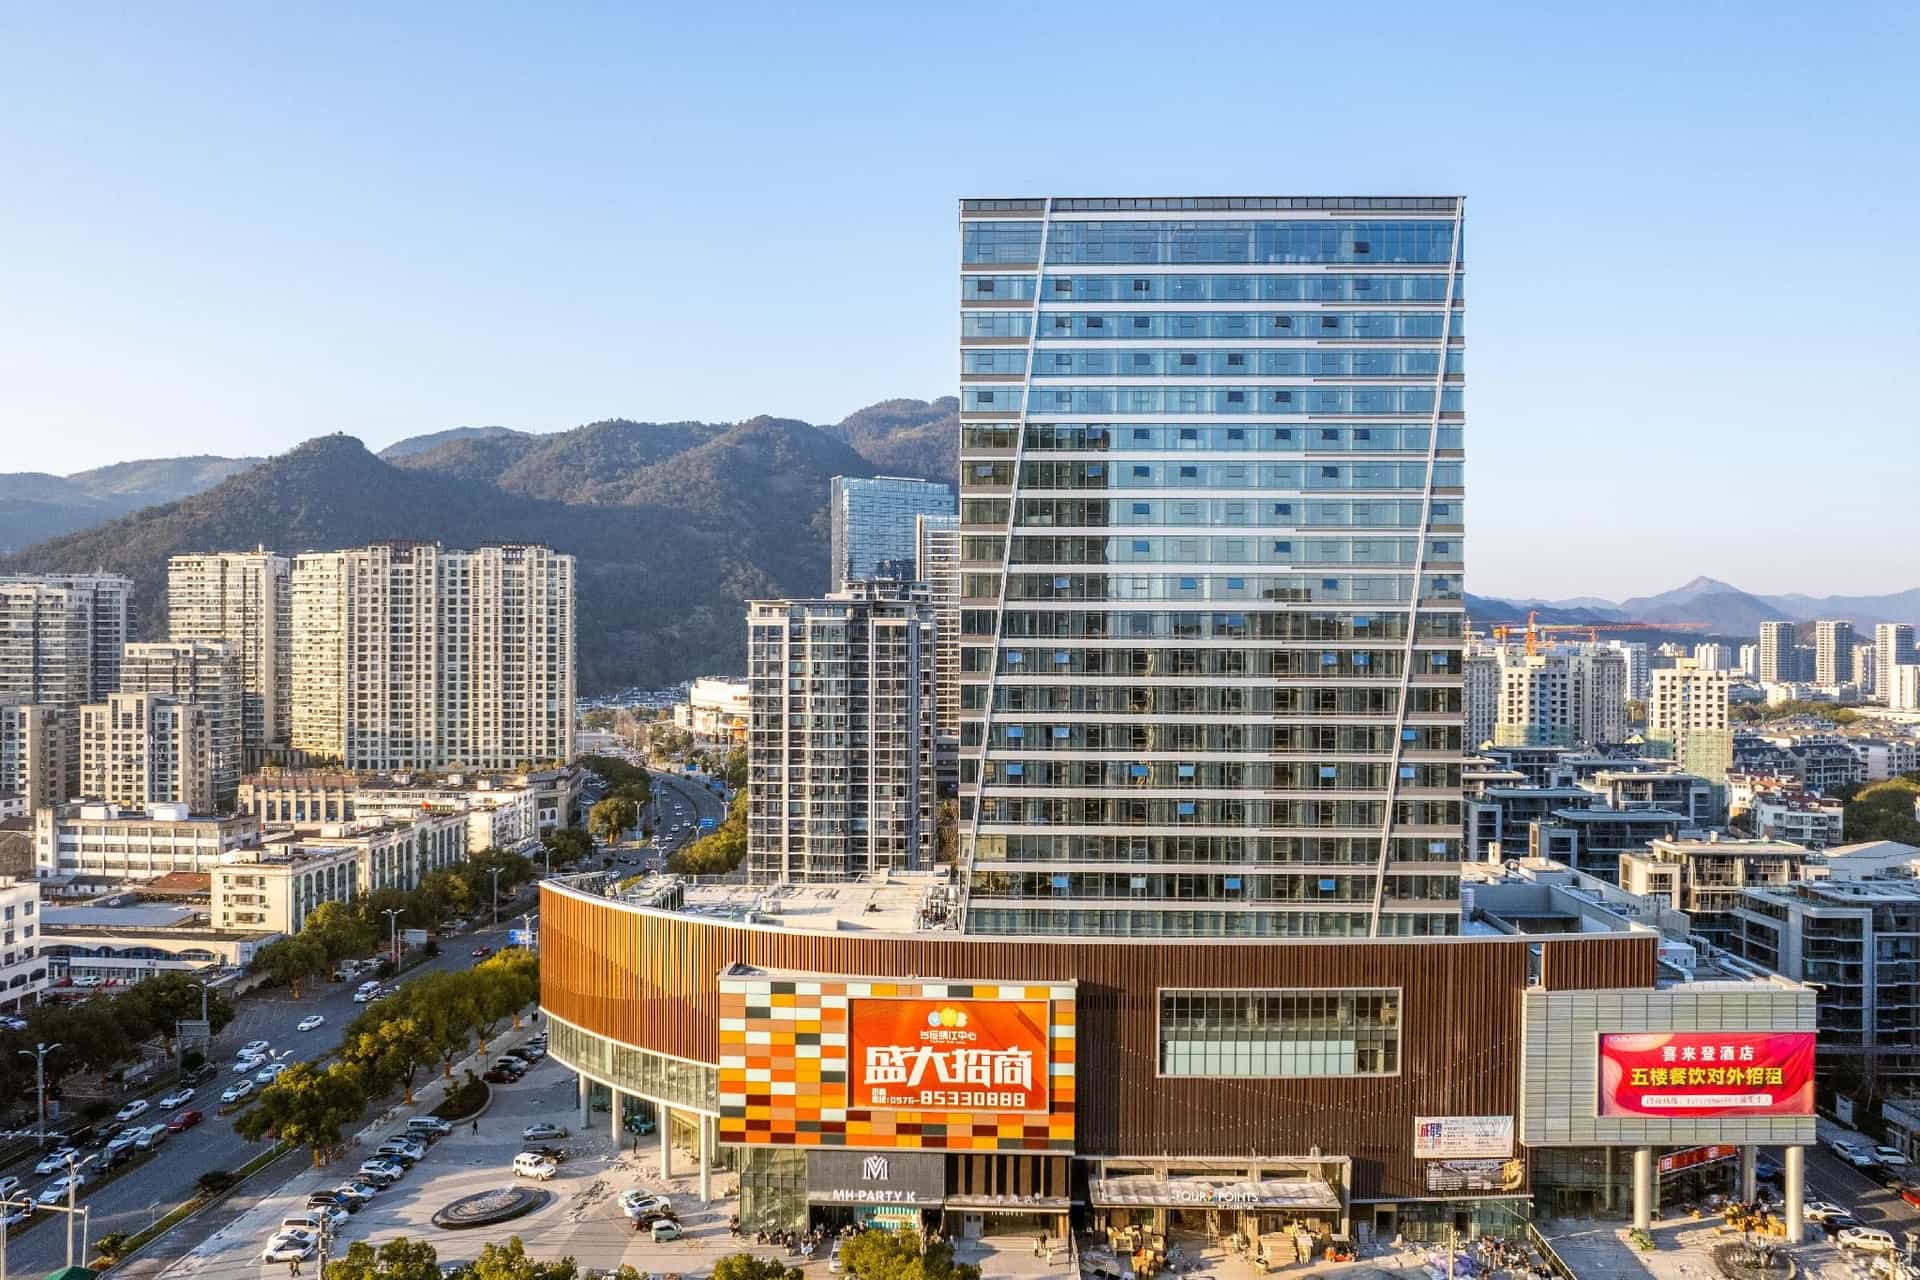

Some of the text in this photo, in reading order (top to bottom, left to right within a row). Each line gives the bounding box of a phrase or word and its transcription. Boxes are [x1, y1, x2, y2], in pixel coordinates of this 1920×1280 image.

[1662, 1045, 1756, 1062] 喜来登酒店
[864, 1045, 1033, 1091] 盛大招商
[1631, 1066, 1784, 1087] 五楼餐饮对外招租
[1176, 1191, 1259, 1202] FOUR POINTS
